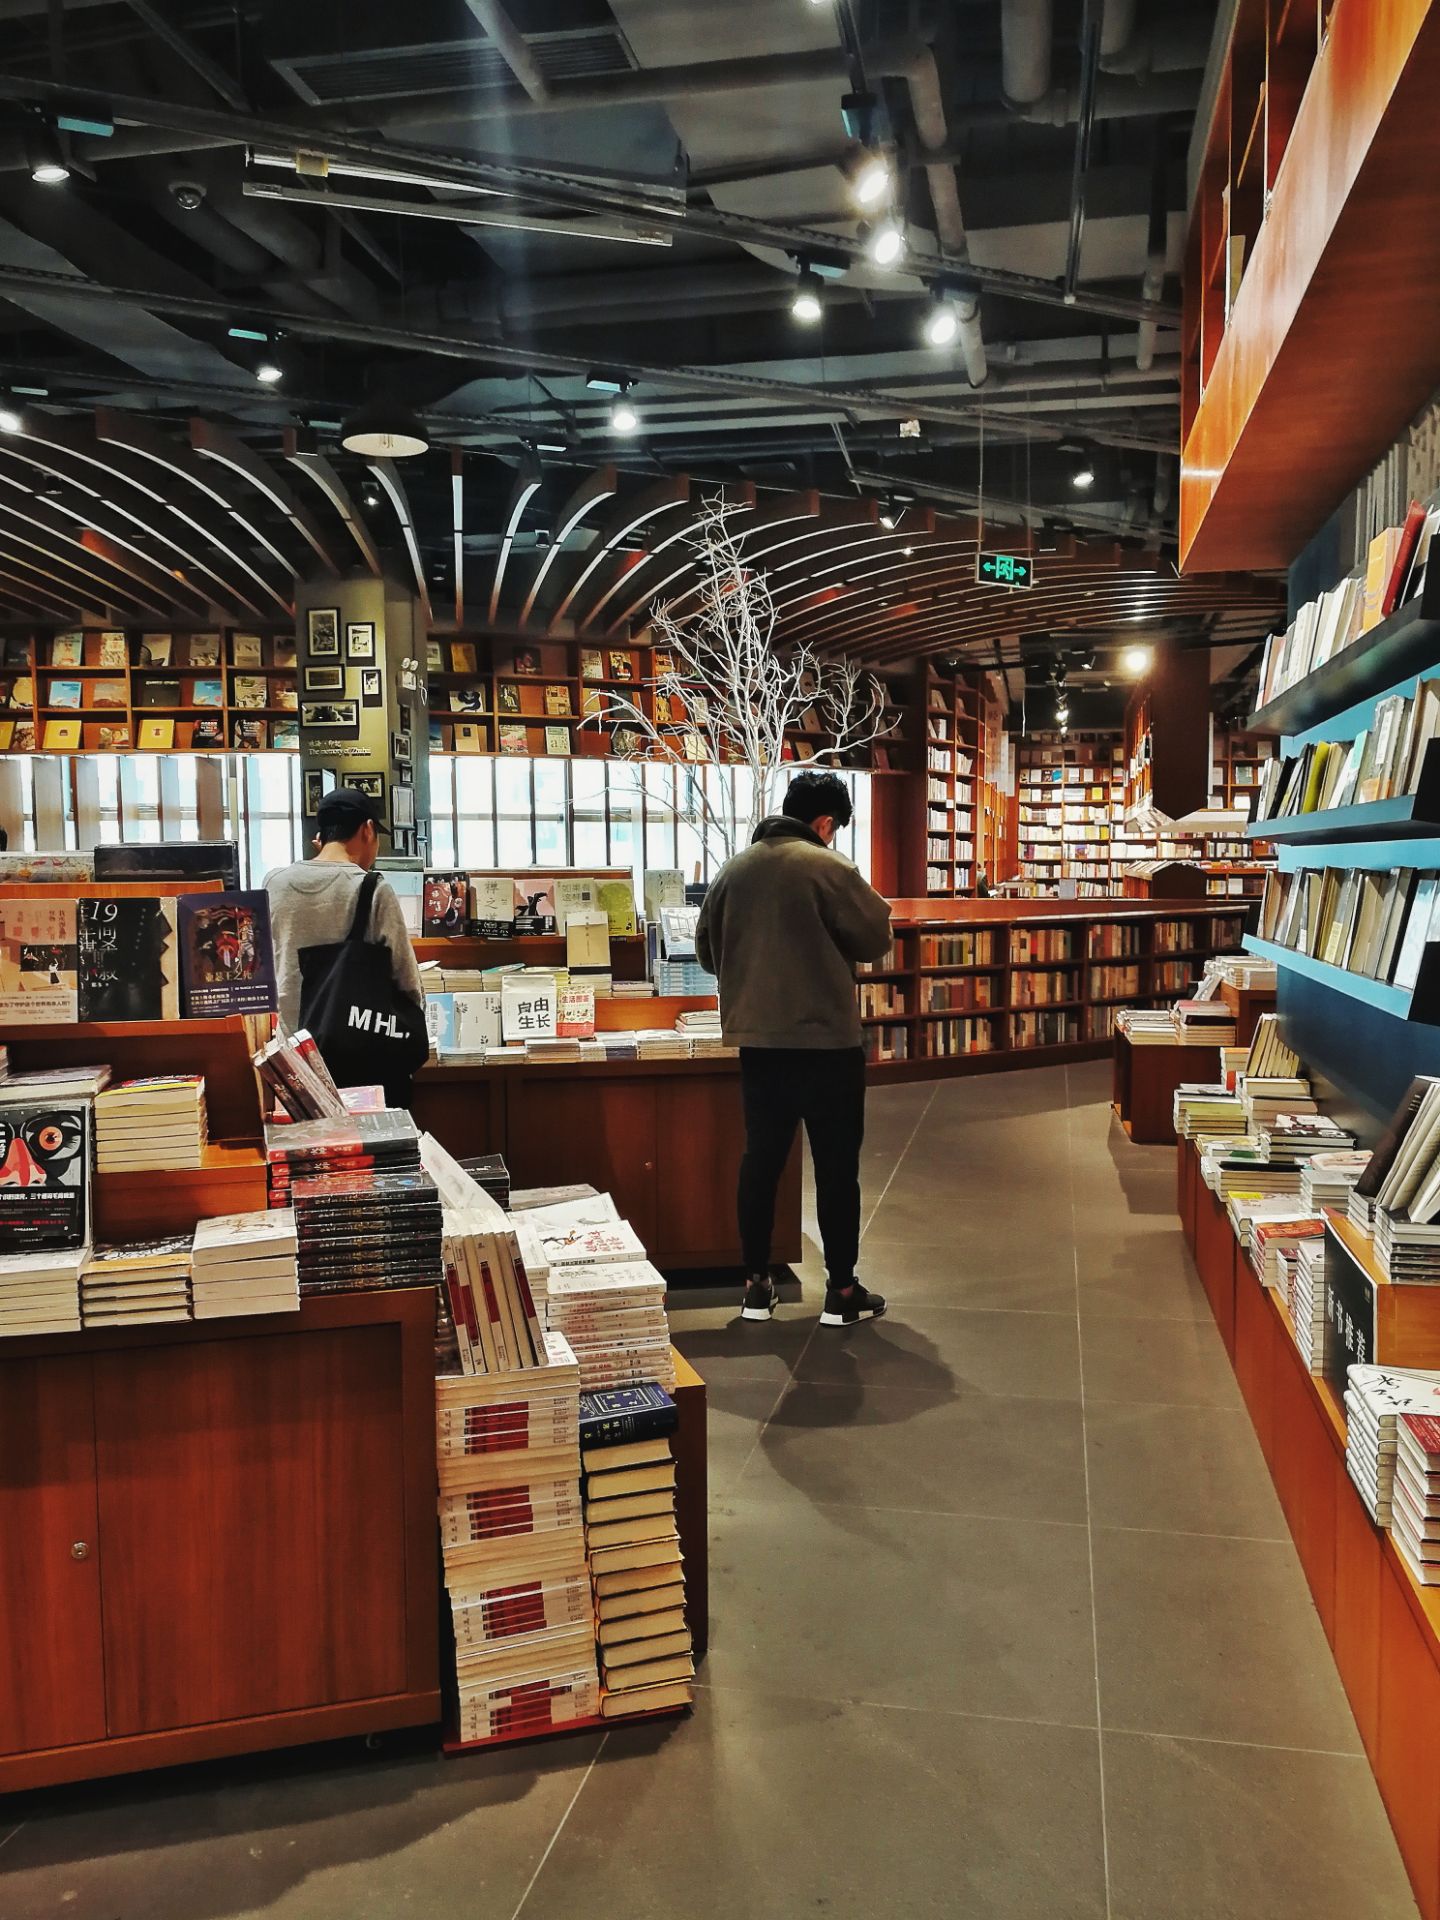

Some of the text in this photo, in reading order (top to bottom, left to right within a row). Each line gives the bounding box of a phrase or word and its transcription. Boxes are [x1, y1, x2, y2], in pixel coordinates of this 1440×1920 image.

[90, 901, 118, 922] 19
[517, 997, 550, 1016] 自由
[518, 1013, 551, 1030] 生长
